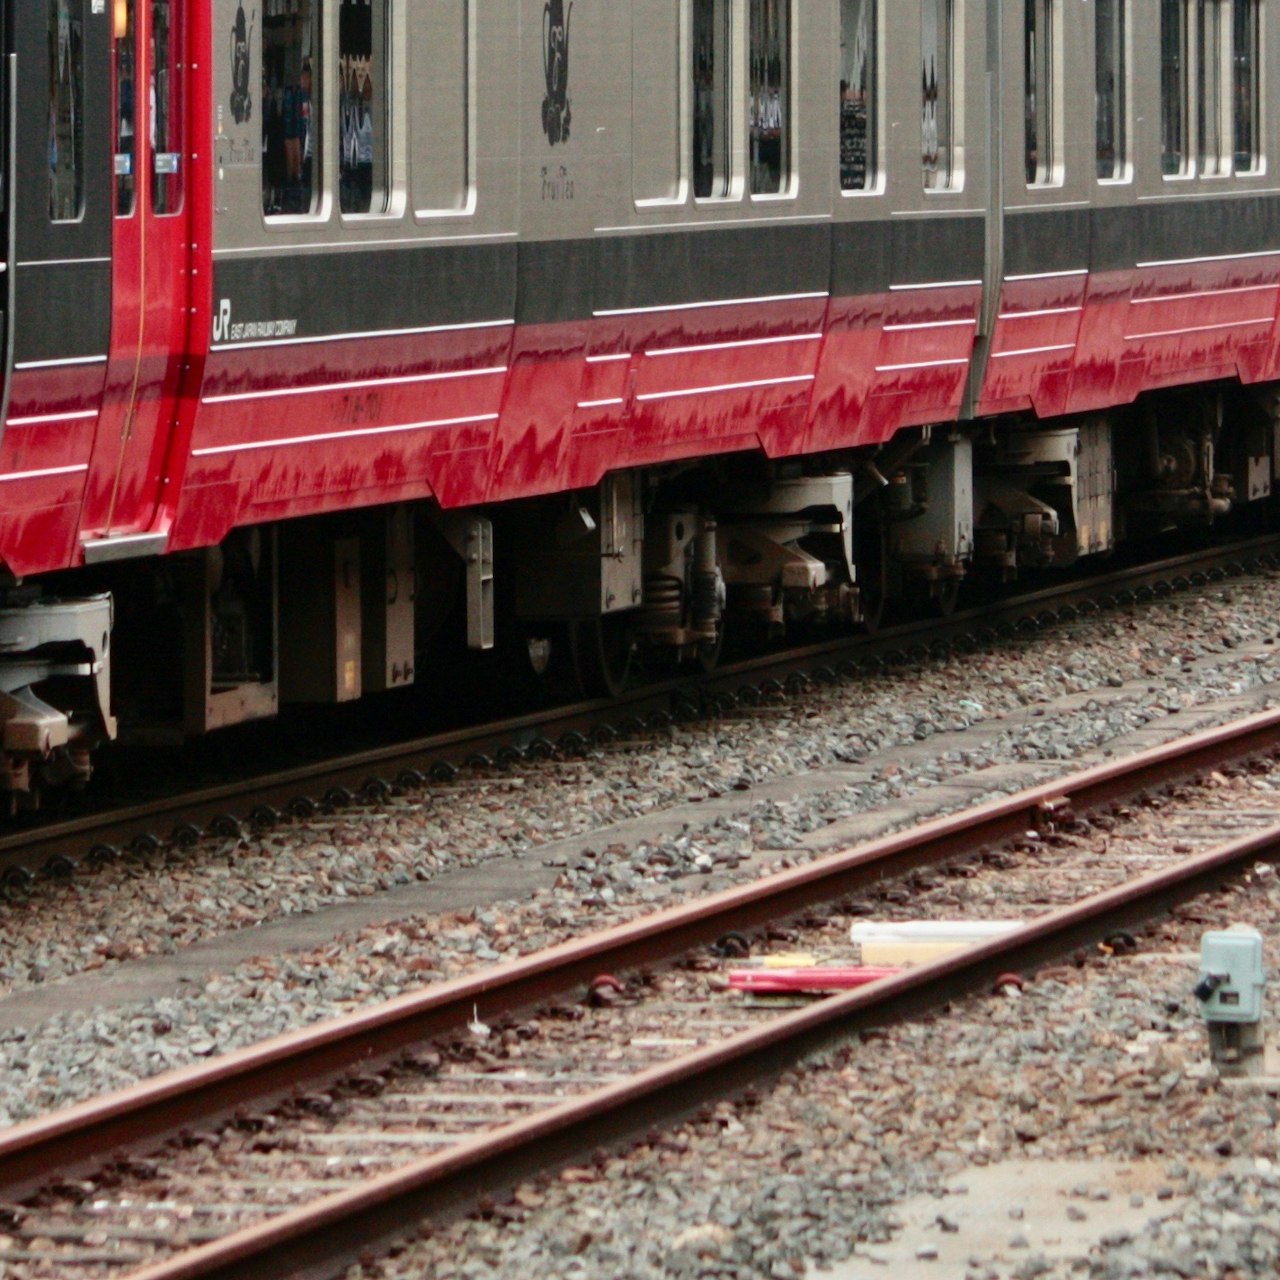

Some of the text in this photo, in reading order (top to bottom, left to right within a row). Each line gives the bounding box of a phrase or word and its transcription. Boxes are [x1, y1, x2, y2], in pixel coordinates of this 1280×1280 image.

[212, 298, 231, 342] JR
[231, 319, 297, 340] EAST JAPAN RAILWAY COMPANY
